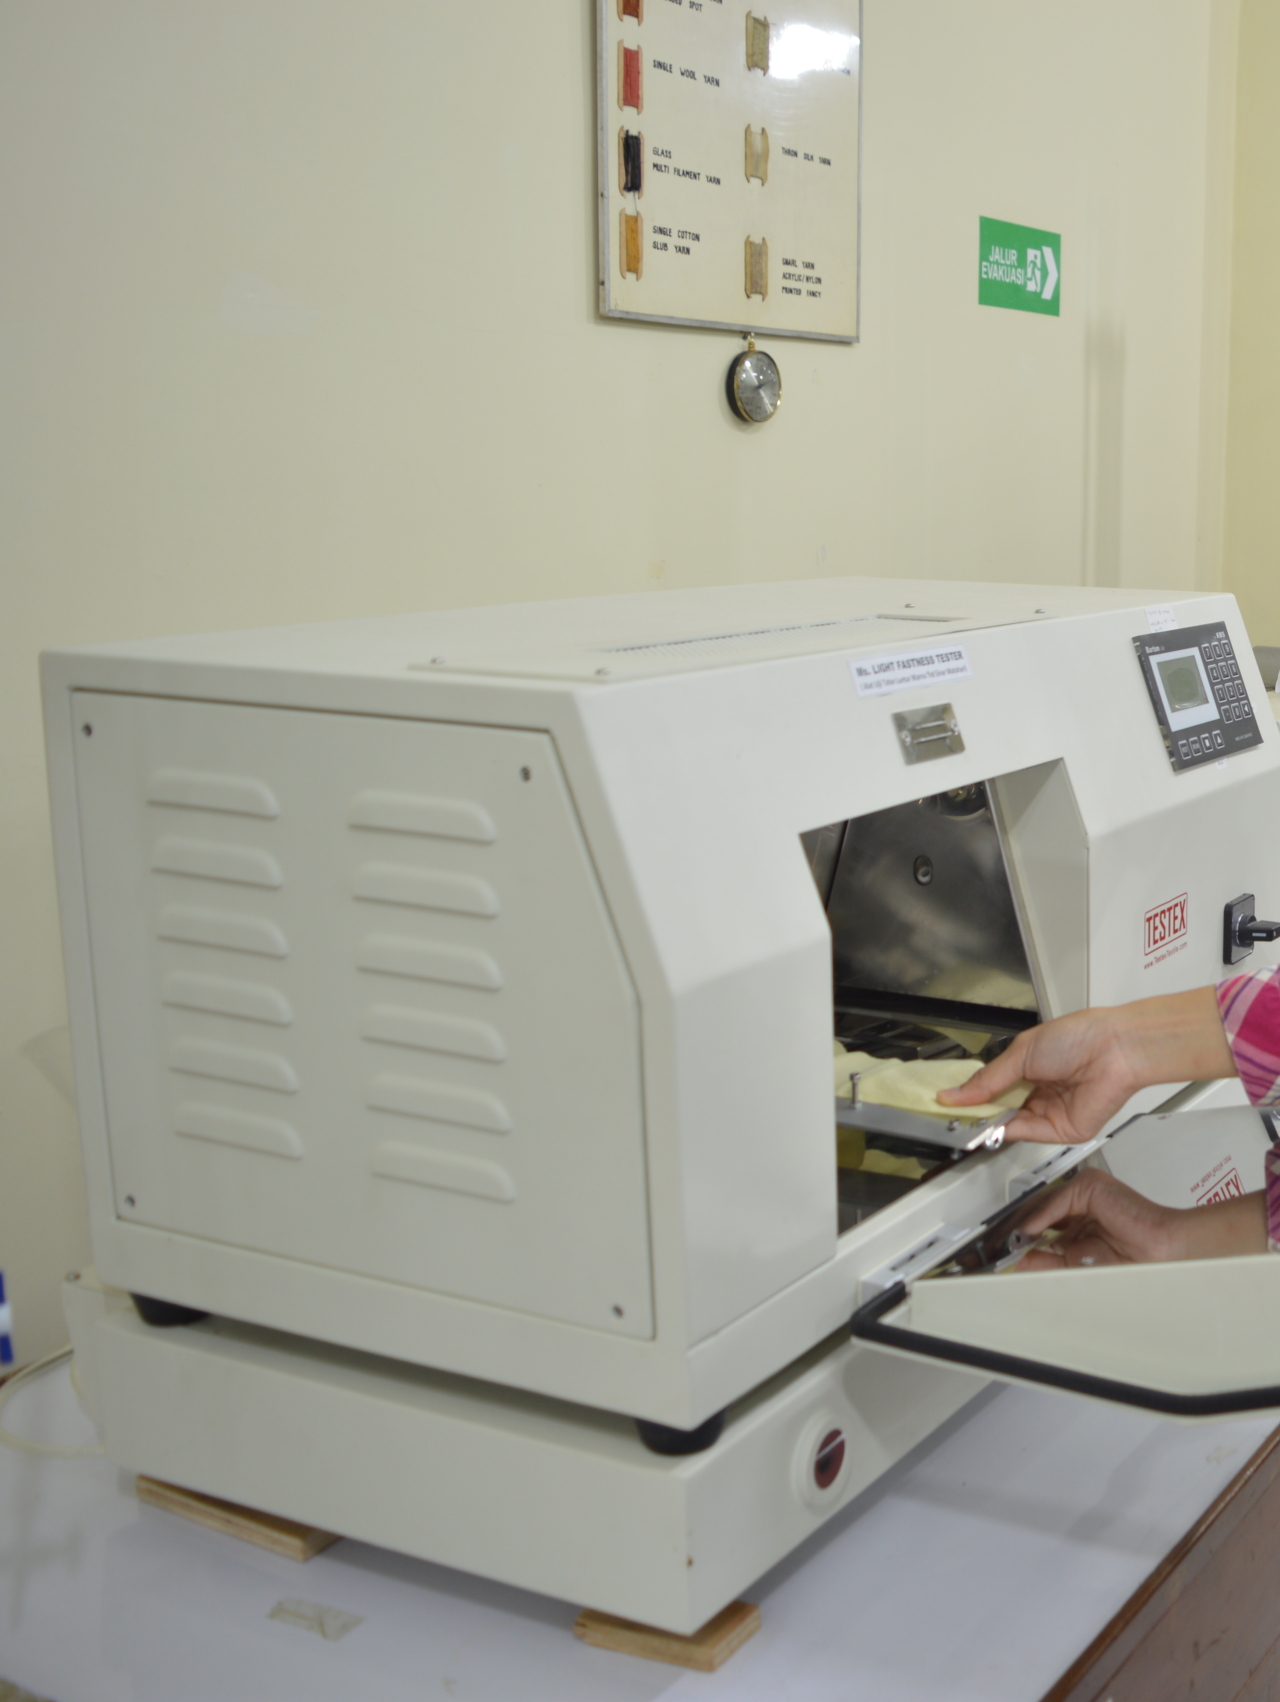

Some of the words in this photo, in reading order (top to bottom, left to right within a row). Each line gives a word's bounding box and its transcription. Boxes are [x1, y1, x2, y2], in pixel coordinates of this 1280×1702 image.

[653, 59, 673, 74] SINGLE
[680, 67, 697, 80] WOOL
[704, 74, 720, 87] YARN
[652, 147, 672, 159] GLASS
[652, 162, 670, 174] MULTI
[674, 167, 700, 180] FILAMENT
[706, 174, 721, 185] YARN
[652, 226, 672, 237] SINGLE
[678, 230, 700, 242] COTTON
[652, 241, 668, 251] SLUB
[674, 244, 690, 255] YARN
[989, 245, 1018, 266] JALUR
[802, 260, 815, 270] YARN
[982, 261, 1025, 285] EVAKUASI
[872, 662, 895, 674] LIGHT
[896, 655, 934, 670] FASTNESS
[935, 650, 964, 664] TESTER
[1213, 668, 1217, 676] 4
[1222, 666, 1227, 675] 5
[1219, 690, 1223, 698] 1
[1229, 688, 1234, 696] 2
[1146, 898, 1186, 948] TESTEX
